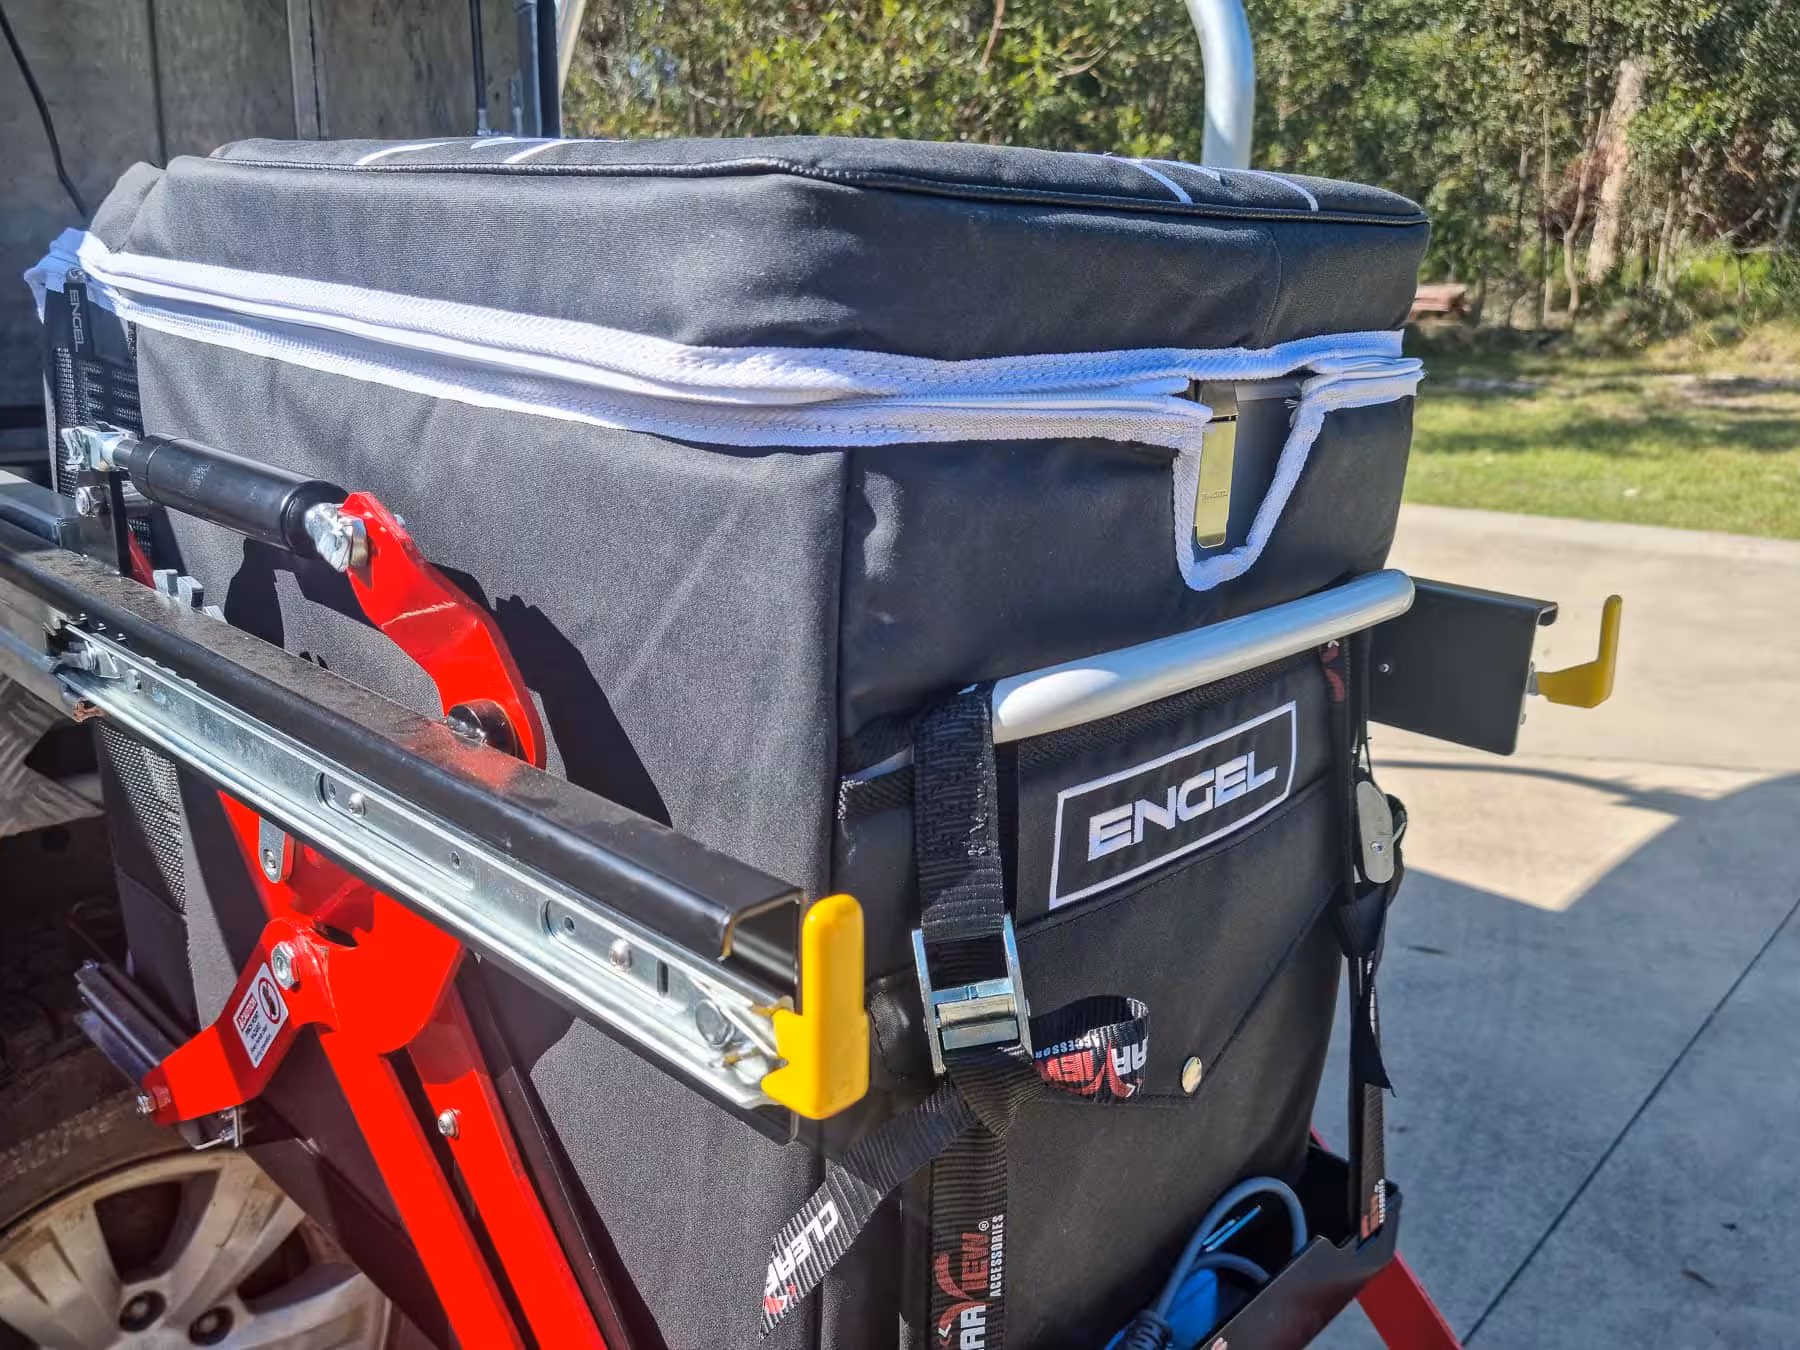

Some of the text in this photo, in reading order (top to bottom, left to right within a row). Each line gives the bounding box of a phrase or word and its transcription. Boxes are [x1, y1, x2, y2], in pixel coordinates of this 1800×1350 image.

[69, 290, 84, 352] ENGEL
[1088, 751, 1278, 861] ENGEL
[990, 1214, 1004, 1297] ACCESSORIES
